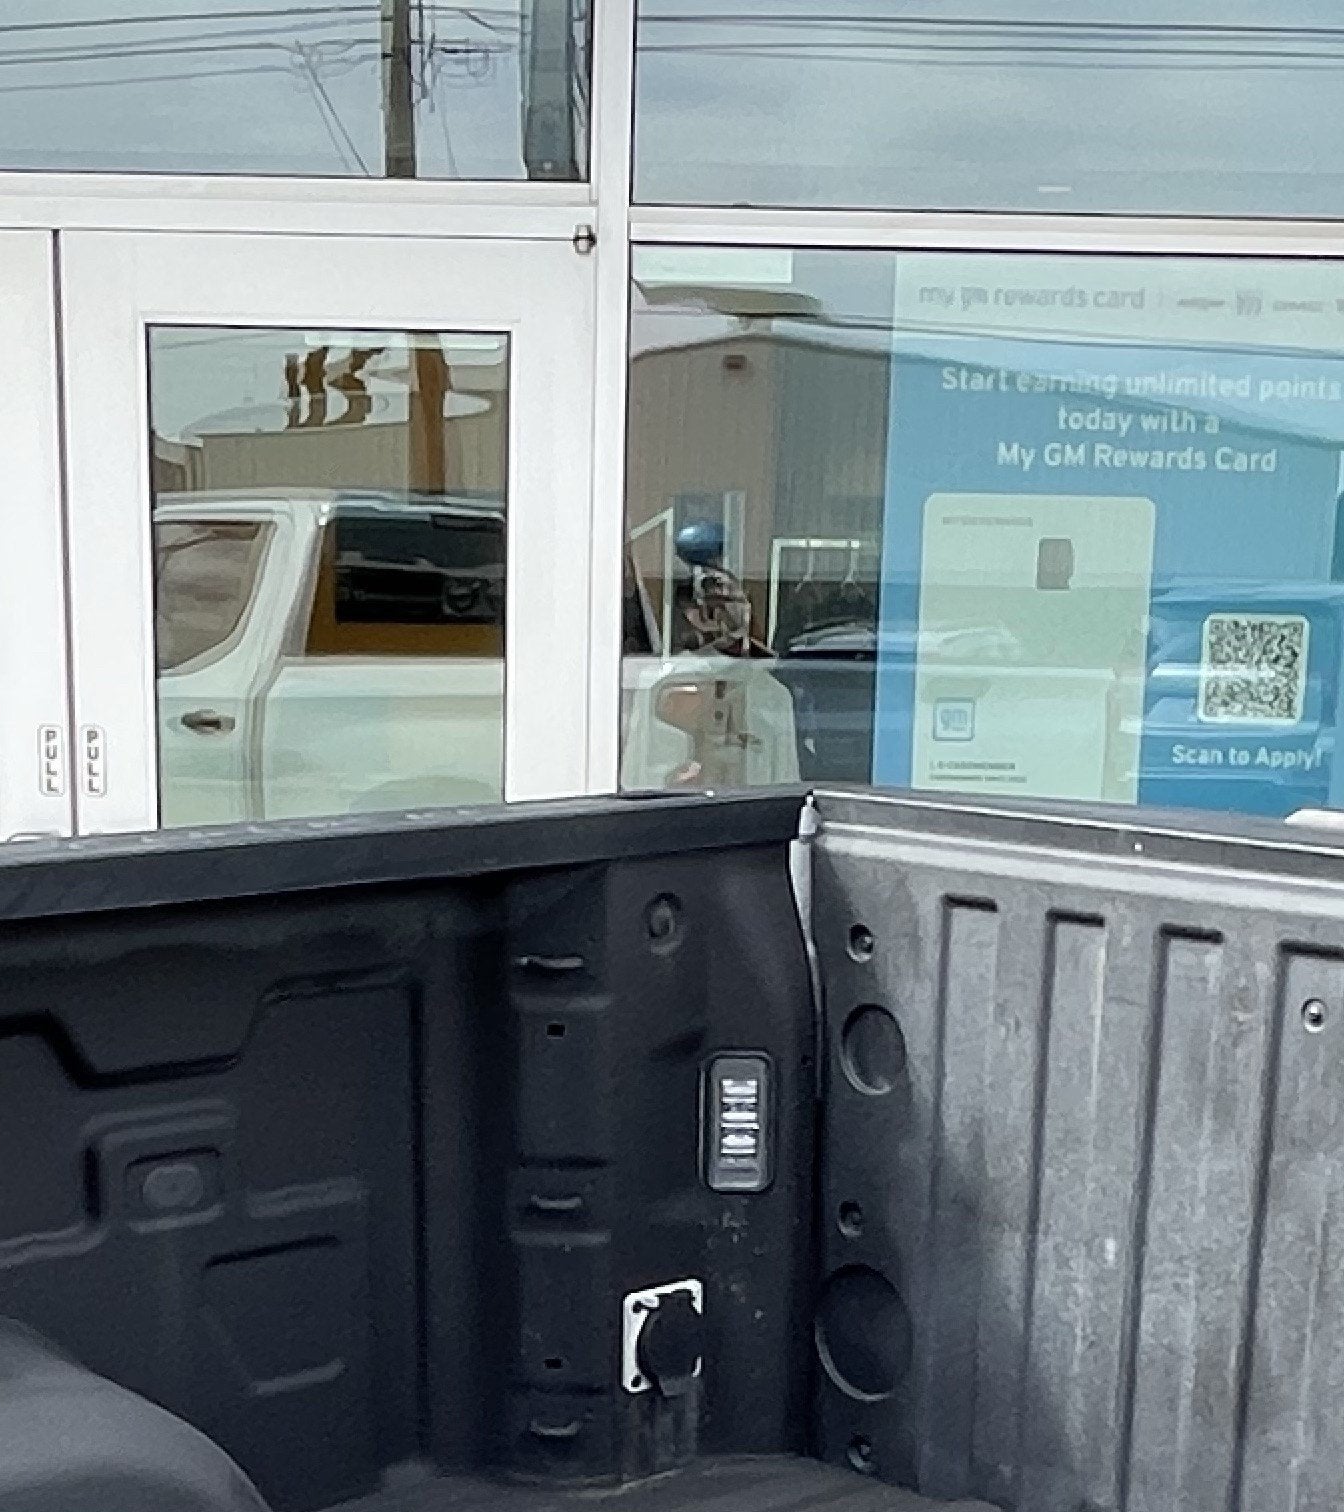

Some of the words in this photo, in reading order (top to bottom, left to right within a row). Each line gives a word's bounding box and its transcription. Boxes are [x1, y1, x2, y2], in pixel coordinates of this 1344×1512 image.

[1093, 287, 1146, 309] card
[942, 366, 1008, 392] Start
[1016, 368, 1119, 400] earning
[1123, 371, 1252, 398] unlimited
[1259, 374, 1342, 402] points
[1058, 405, 1133, 438] today
[1140, 408, 1197, 434] with
[1204, 414, 1221, 434] a
[996, 441, 1036, 472] My
[1043, 441, 1087, 467] GM
[1093, 442, 1207, 471] Rewards
[1214, 446, 1278, 472] Card
[45, 730, 58, 792] PULL
[86, 730, 99, 792] PULL
[1171, 744, 1225, 765] Scan
[1228, 746, 1250, 766] to
[1254, 746, 1323, 772] Apply!
